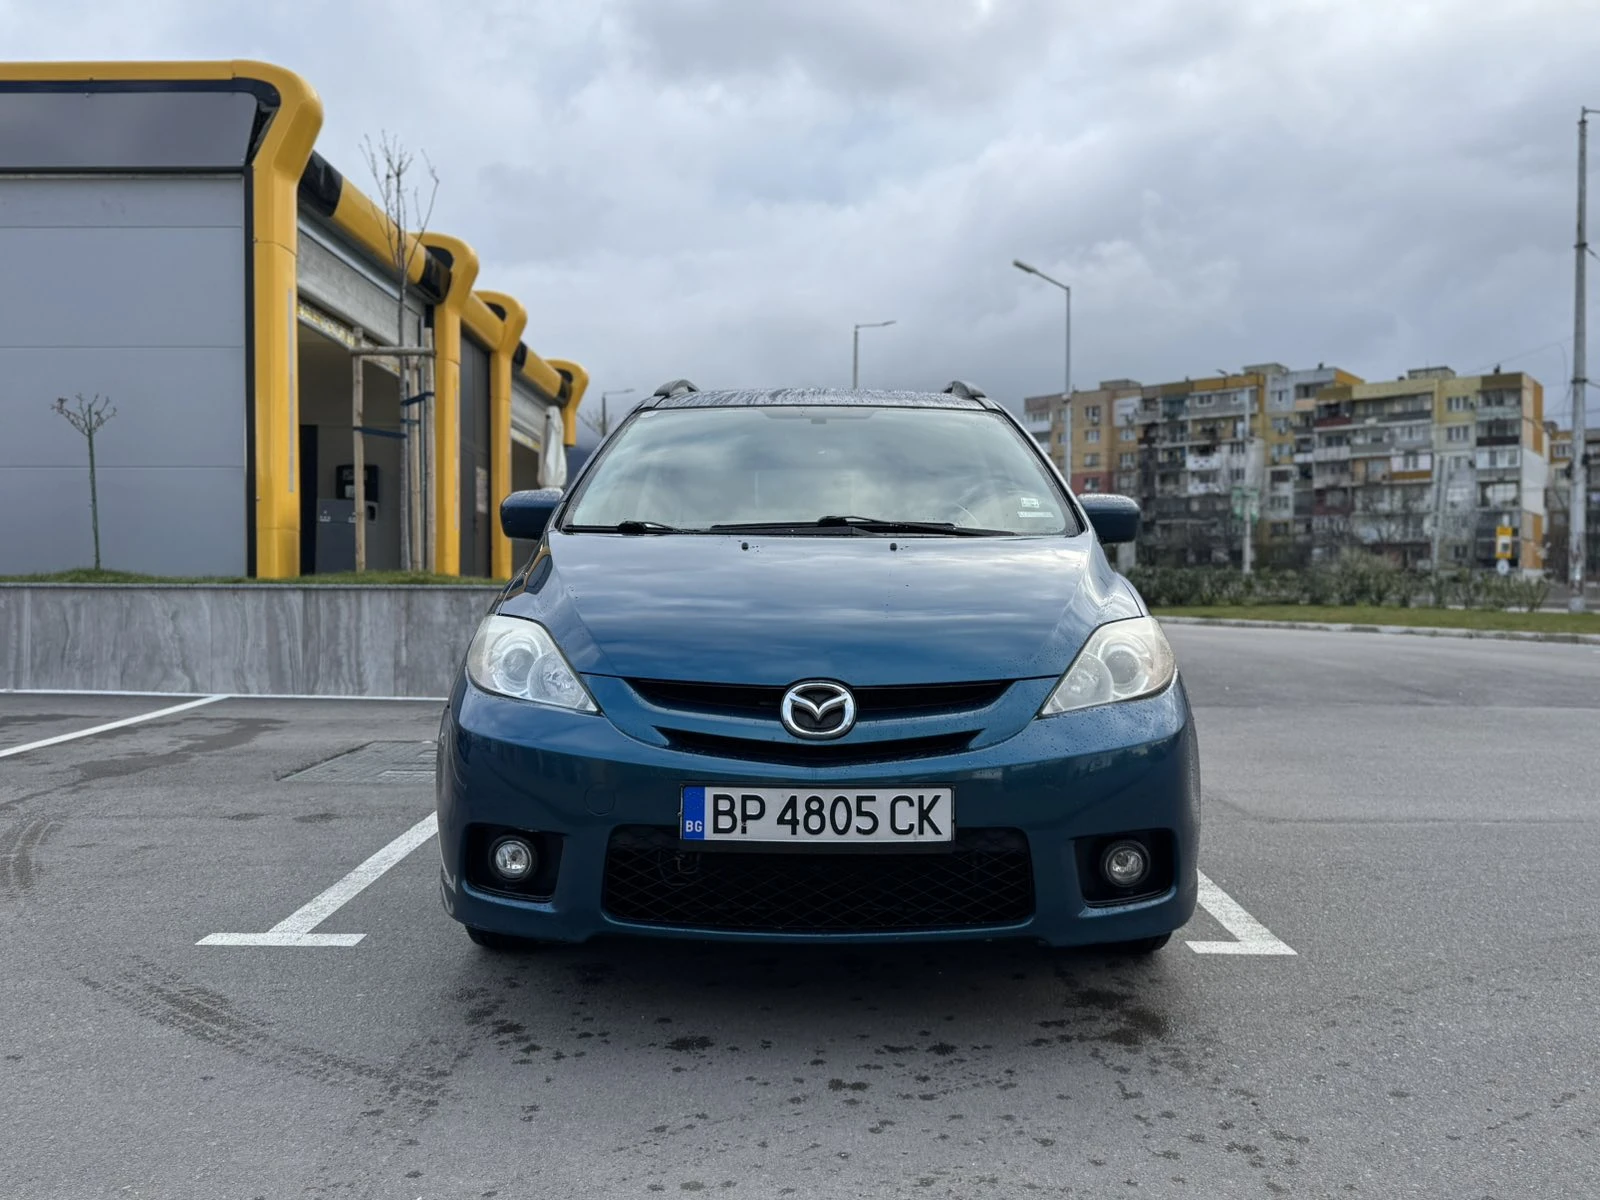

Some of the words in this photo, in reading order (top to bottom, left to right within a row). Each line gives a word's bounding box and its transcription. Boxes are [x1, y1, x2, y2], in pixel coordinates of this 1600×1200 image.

[685, 820, 703, 833] BG
[713, 794, 766, 834] BP
[776, 795, 879, 836] 4805
[889, 794, 943, 835] CK
